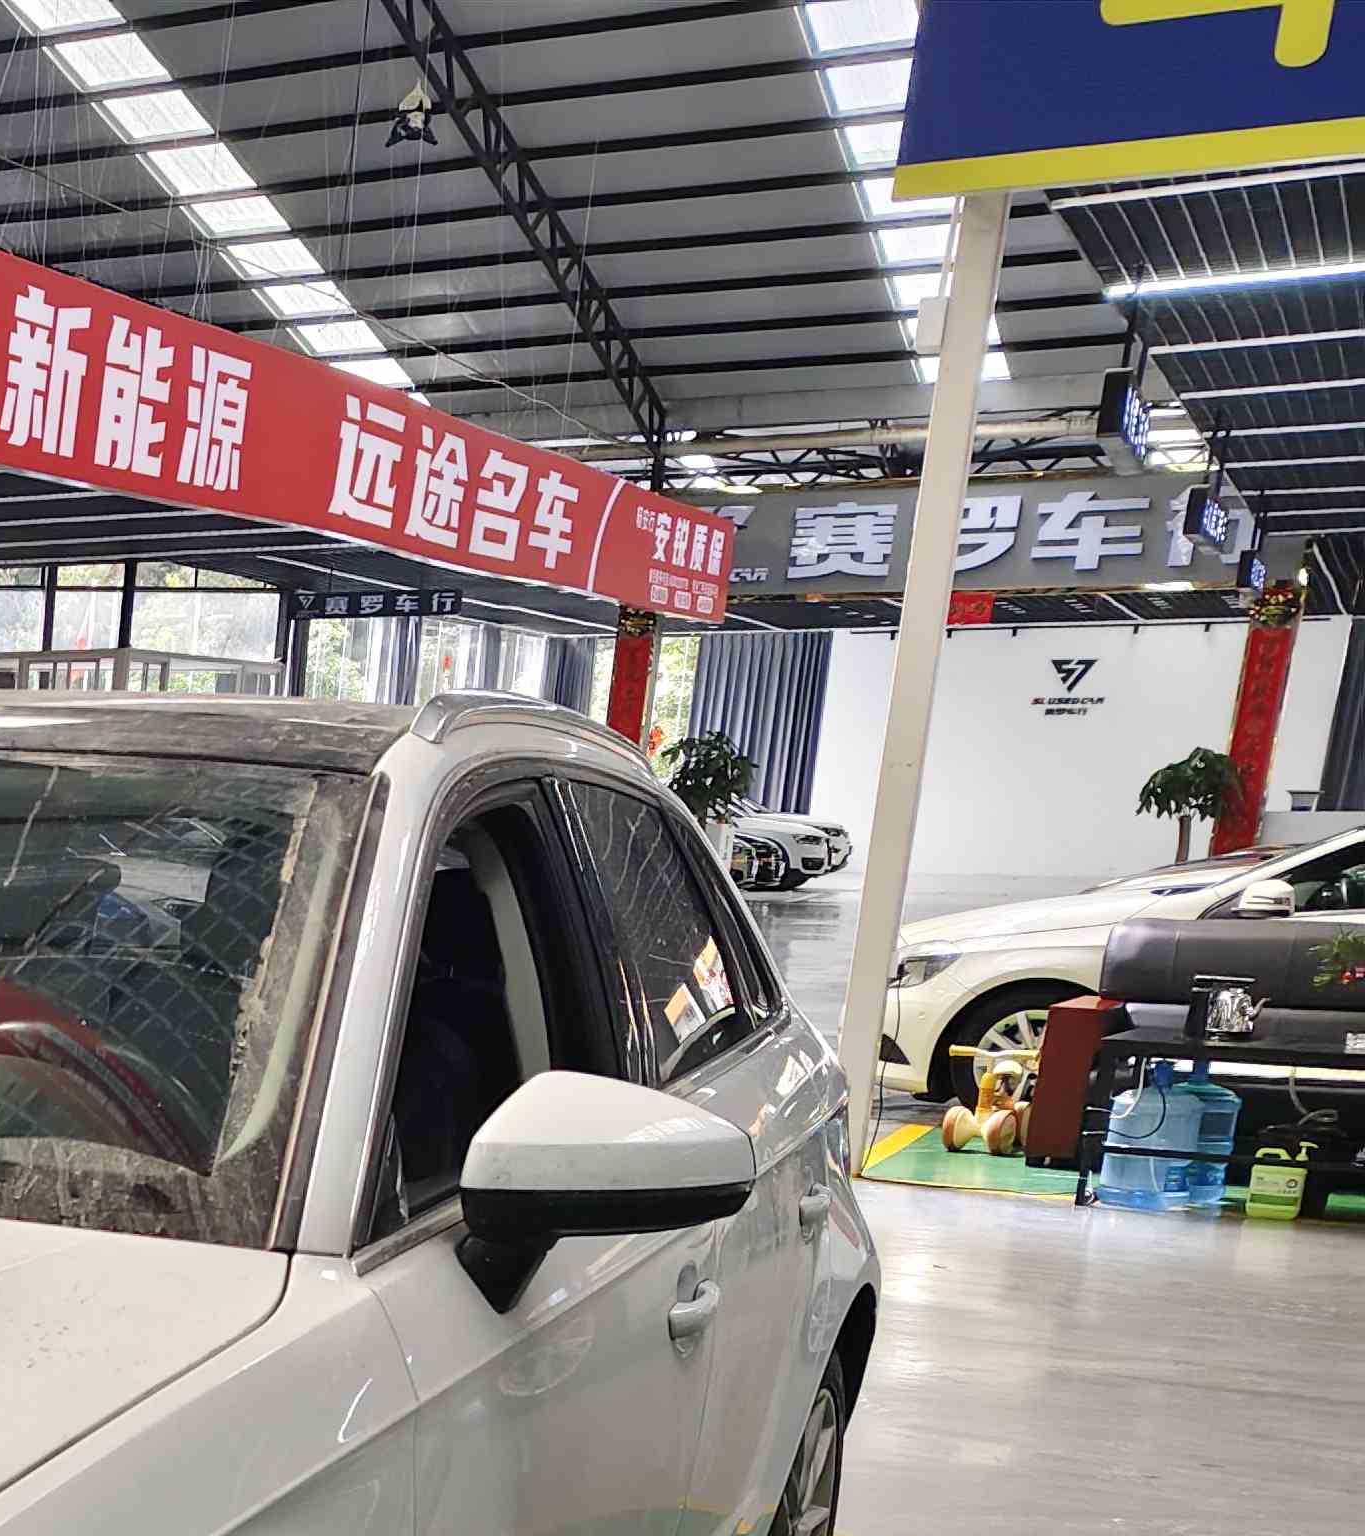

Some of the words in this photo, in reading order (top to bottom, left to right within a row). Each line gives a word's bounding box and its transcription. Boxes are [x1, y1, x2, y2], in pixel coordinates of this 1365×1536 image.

[328, 394, 581, 570] 远途名车
[652, 512, 726, 577] 安锐质保
[324, 592, 456, 615] 赛罗车行
